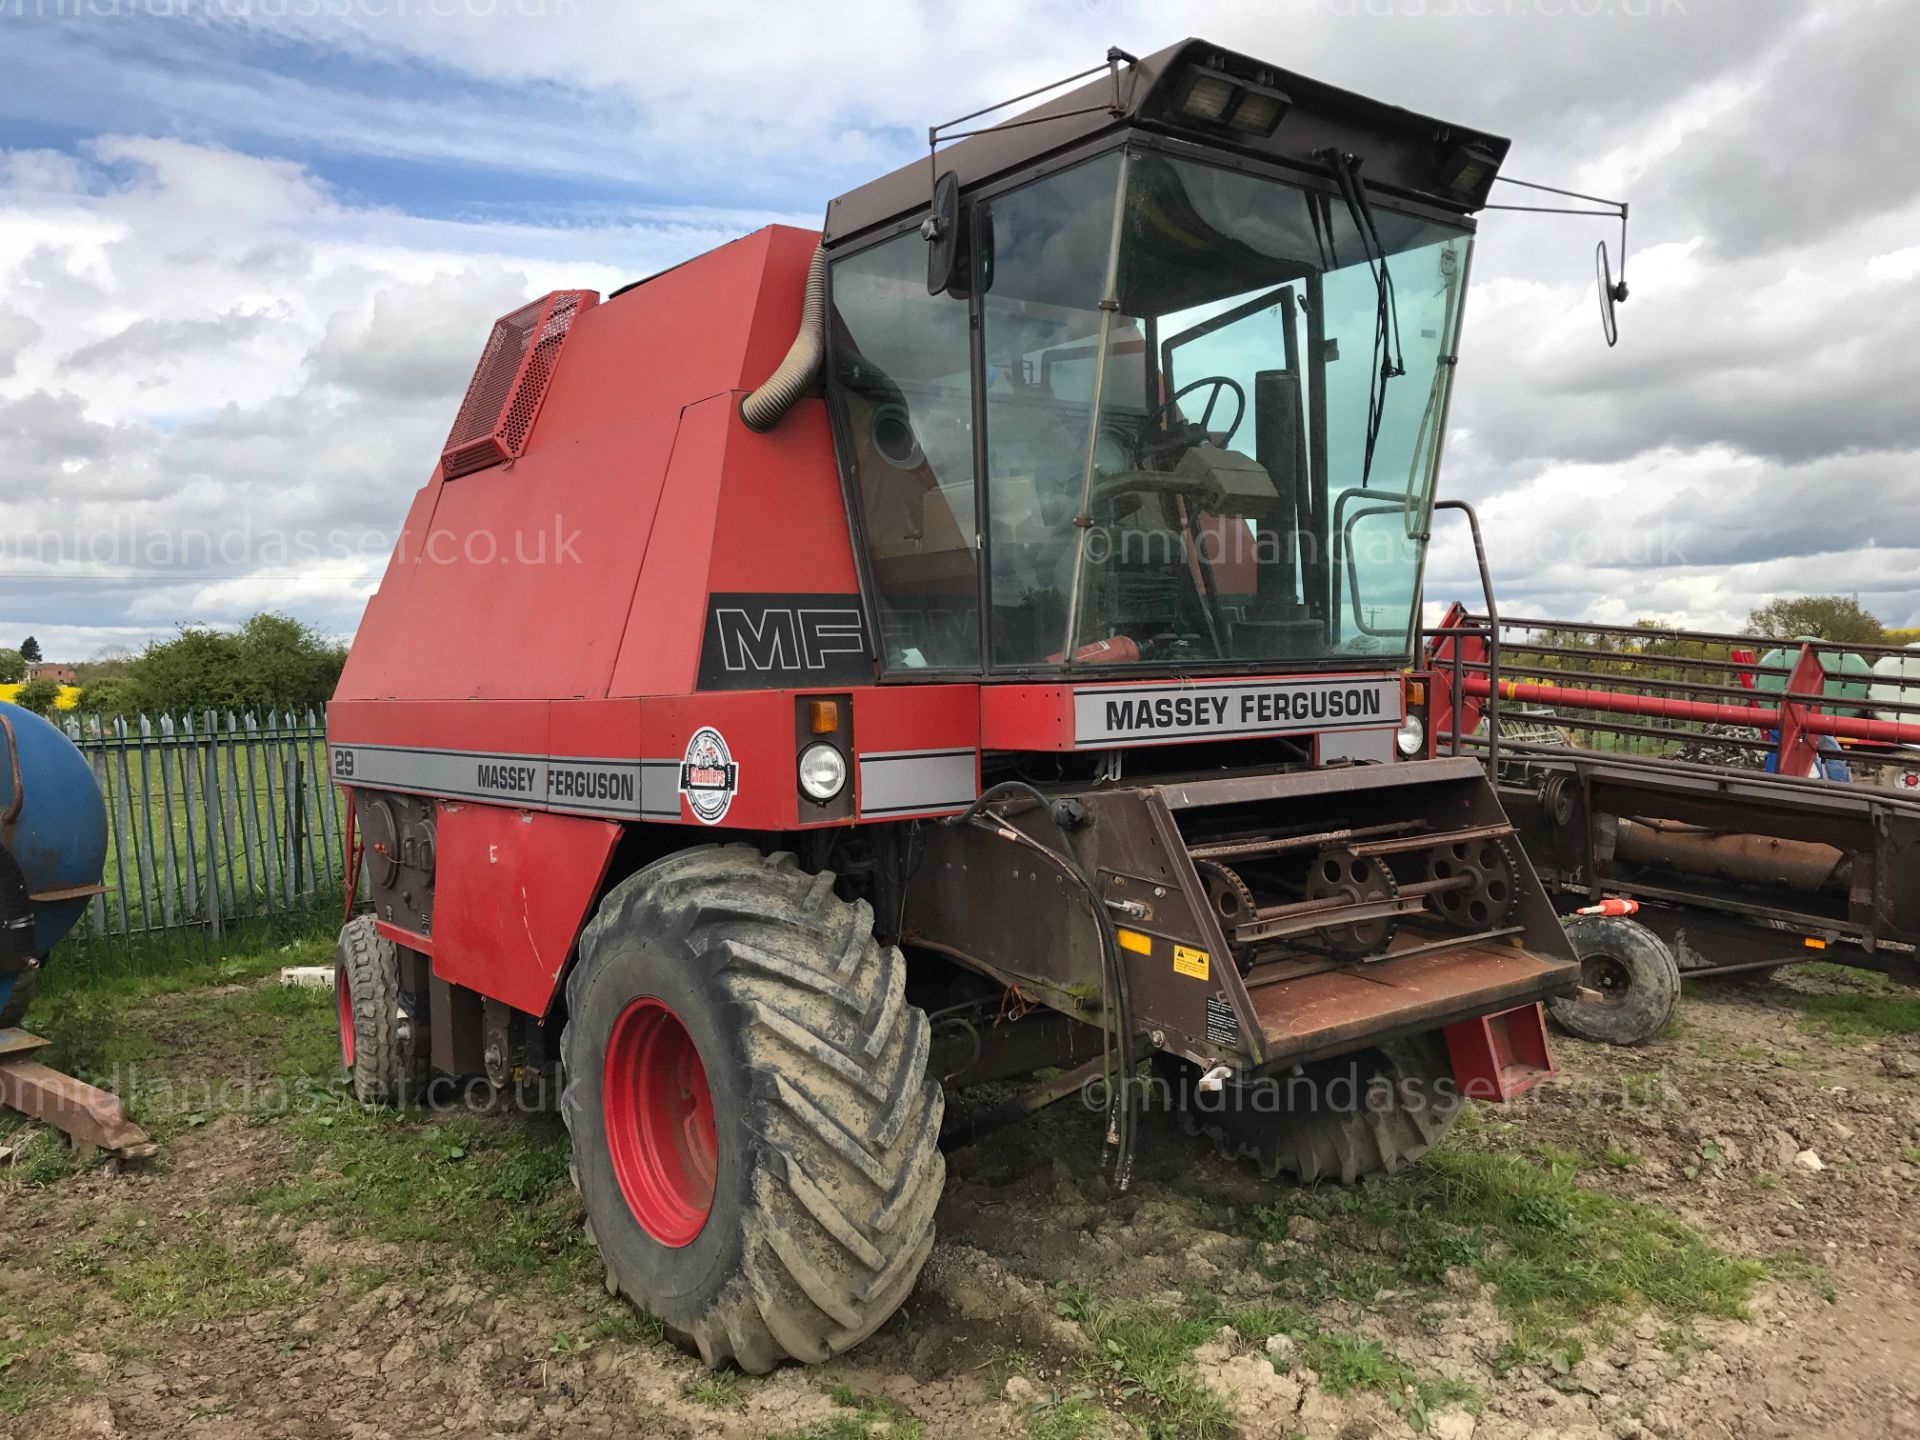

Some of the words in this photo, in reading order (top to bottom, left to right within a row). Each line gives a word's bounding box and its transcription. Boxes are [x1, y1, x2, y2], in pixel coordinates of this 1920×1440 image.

[715, 608, 864, 670] MF
[1106, 696, 1229, 731] MASSEY
[1240, 689, 1380, 723] FERGUSON
[335, 750, 354, 776] 29
[477, 763, 536, 792] MASSEY
[548, 769, 634, 801] FERGUSON
